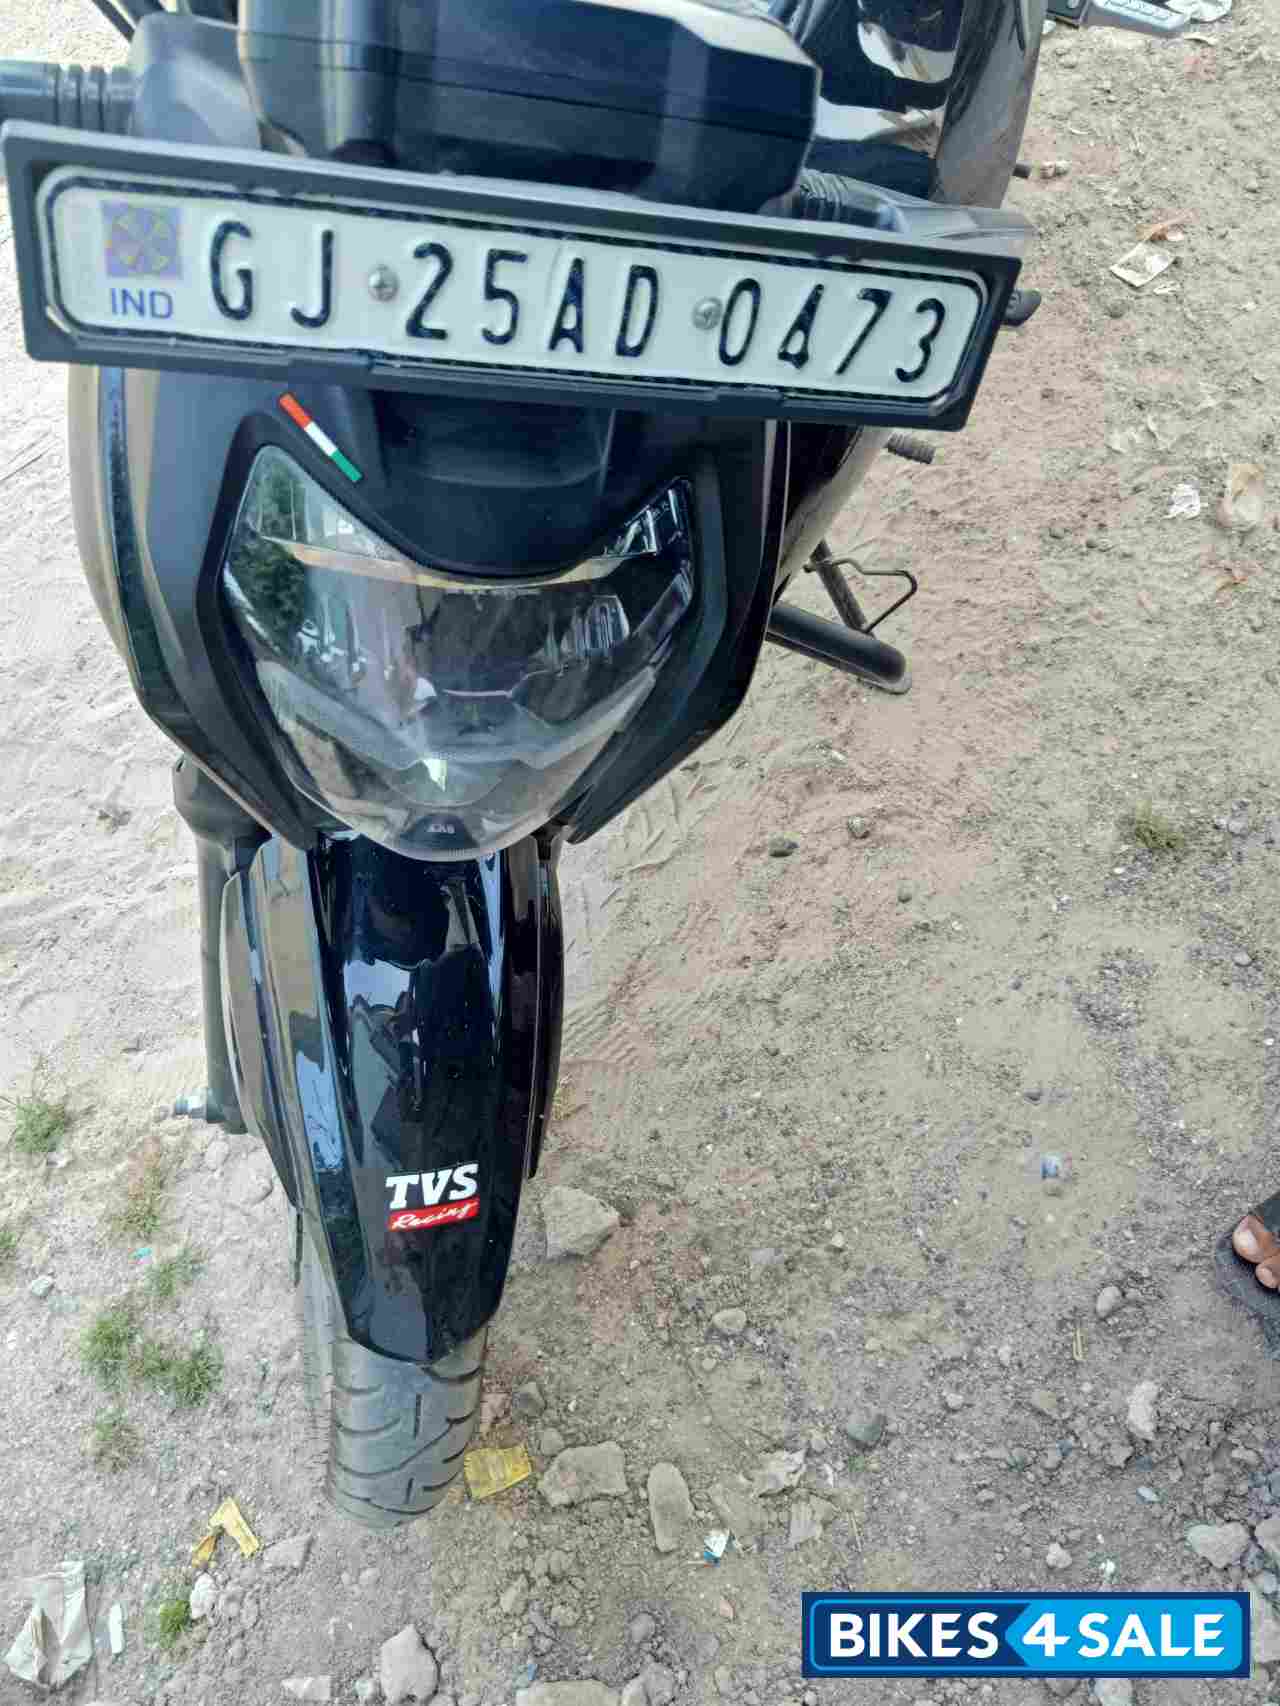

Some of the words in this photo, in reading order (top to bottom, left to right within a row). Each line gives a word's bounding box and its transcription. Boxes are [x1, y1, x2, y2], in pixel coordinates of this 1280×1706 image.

[111, 288, 173, 319] IND
[209, 220, 335, 328] GJ
[405, 242, 659, 357] 25AD
[718, 278, 946, 382] 0473
[385, 1163, 479, 1210] TVS
[390, 1201, 479, 1230] Racing
